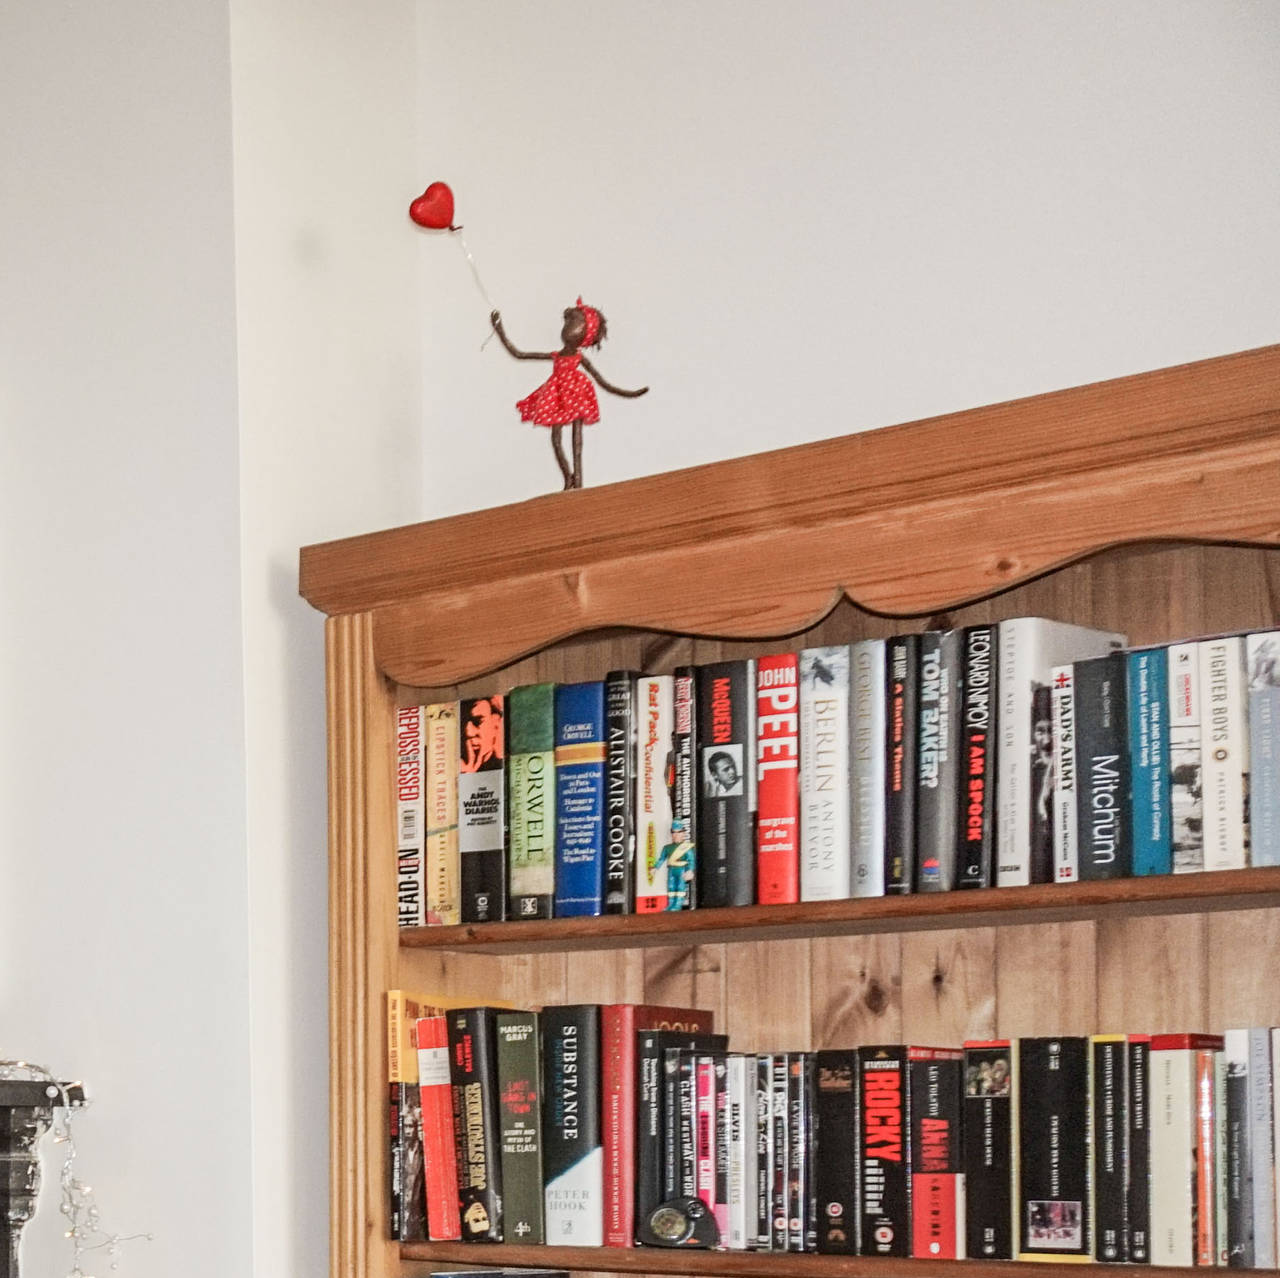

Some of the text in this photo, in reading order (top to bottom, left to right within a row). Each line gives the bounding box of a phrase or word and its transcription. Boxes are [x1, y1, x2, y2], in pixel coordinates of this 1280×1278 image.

[711, 677, 732, 743] McQUEEN
[758, 665, 797, 687] JOHN
[855, 652, 872, 762] GEORGE BEST
[966, 630, 991, 729] LEONARD NIMOY
[1005, 693, 1016, 716] AND
[1210, 646, 1228, 742] FIGHTER BOYS
[647, 682, 659, 746] Rat Pack
[757, 686, 798, 781] PEEL
[814, 698, 839, 793] BERLIN
[920, 649, 941, 789] TOM BAKER?
[1060, 695, 1074, 794] DAD'S ARMY
[397, 705, 420, 801] REPOSSESSED
[644, 743, 657, 813] Confidential
[682, 737, 691, 816] THE AUTHORISED
[969, 747, 986, 776] AM
[435, 781, 447, 821] TRACES
[463, 799, 501, 809] WARHOL
[464, 806, 499, 816] DIARIES
[470, 791, 495, 800] ANDY
[527, 755, 544, 860] ORWELL
[608, 728, 626, 880] ALISTAIR COOKE
[967, 780, 985, 841] SPOCK
[1091, 755, 1120, 865] Mitchum
[808, 803, 819, 871] BEEVOR
[821, 799, 835, 872] ANTONY
[506, 1032, 529, 1042] GRAY
[562, 1024, 579, 1140] SUBSTANCE
[864, 1070, 902, 1162] ROCKY
[465, 1082, 487, 1190] JOE STRUMMER
[921, 1118, 949, 1172] ANNA
[547, 1189, 590, 1200] PETER
[549, 1200, 587, 1211] HOOK
